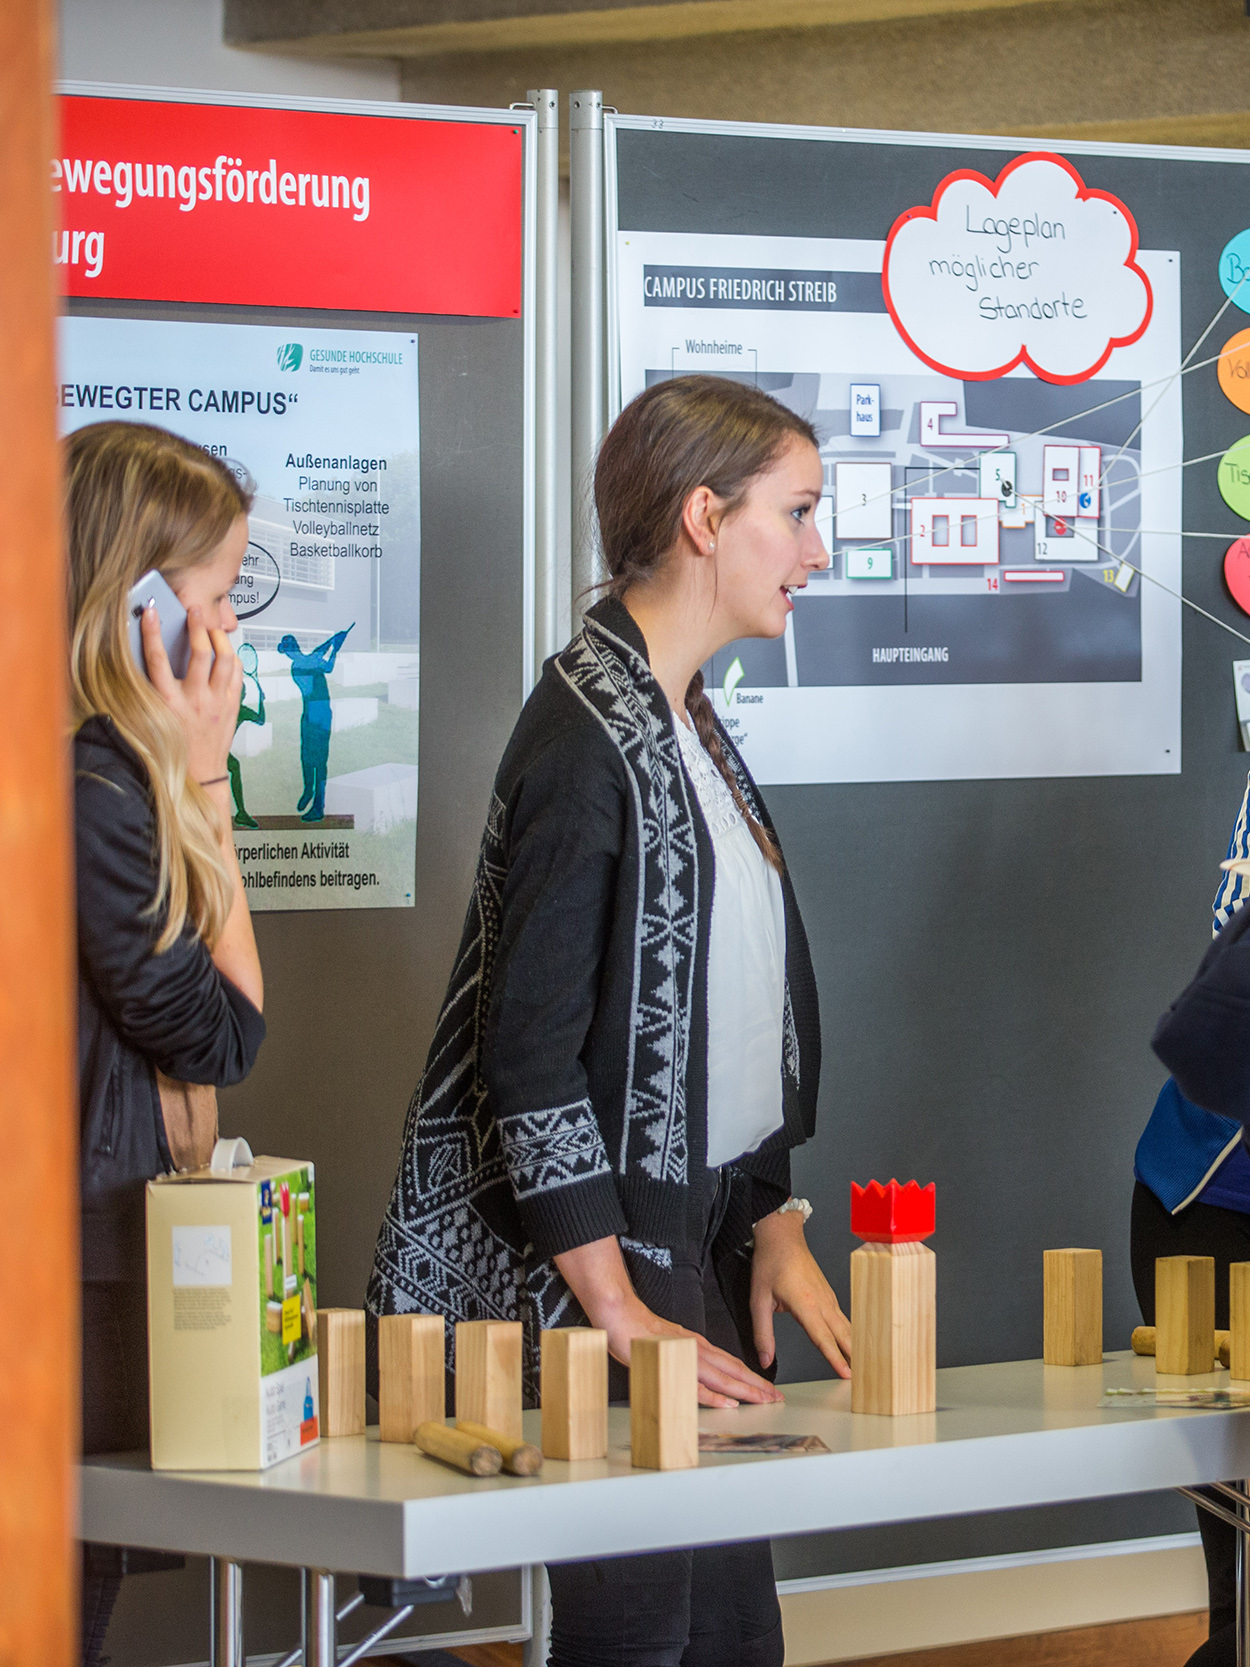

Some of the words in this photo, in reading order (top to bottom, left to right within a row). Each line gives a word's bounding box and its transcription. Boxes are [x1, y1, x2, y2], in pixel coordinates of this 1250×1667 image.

[50, 155, 370, 222] ewegungsförderung
[966, 205, 1066, 253] Lageplan
[53, 230, 105, 278] urg
[929, 254, 1040, 292] möglicher
[644, 276, 706, 299] CAMPUS
[709, 278, 786, 302] FRIEDRICH
[788, 280, 838, 303] STREIB
[979, 291, 1088, 320] Standorte
[685, 339, 743, 355] Wohnheime
[309, 349, 347, 363] GESUNDE
[349, 351, 404, 365] HOCHSCHULE
[856, 393, 875, 405] Park-
[856, 410, 874, 422] haus
[927, 417, 934, 430] 4
[198, 444, 228, 457] sen
[285, 453, 388, 474] Außenanlagen
[299, 476, 350, 495] Planung
[354, 480, 378, 492] von
[283, 497, 390, 517] Tischtennisplatte
[293, 520, 380, 538] Volleyballnetz
[290, 542, 383, 559] Basketballkorb
[1037, 542, 1048, 555] 12
[242, 554, 260, 566] ehr
[987, 578, 999, 591] 14
[1103, 569, 1115, 583] 13
[872, 647, 950, 663] HAUPTEINGANG
[736, 693, 764, 704] Banane
[301, 842, 350, 860] Aktivität
[320, 870, 380, 891] beitragen.
